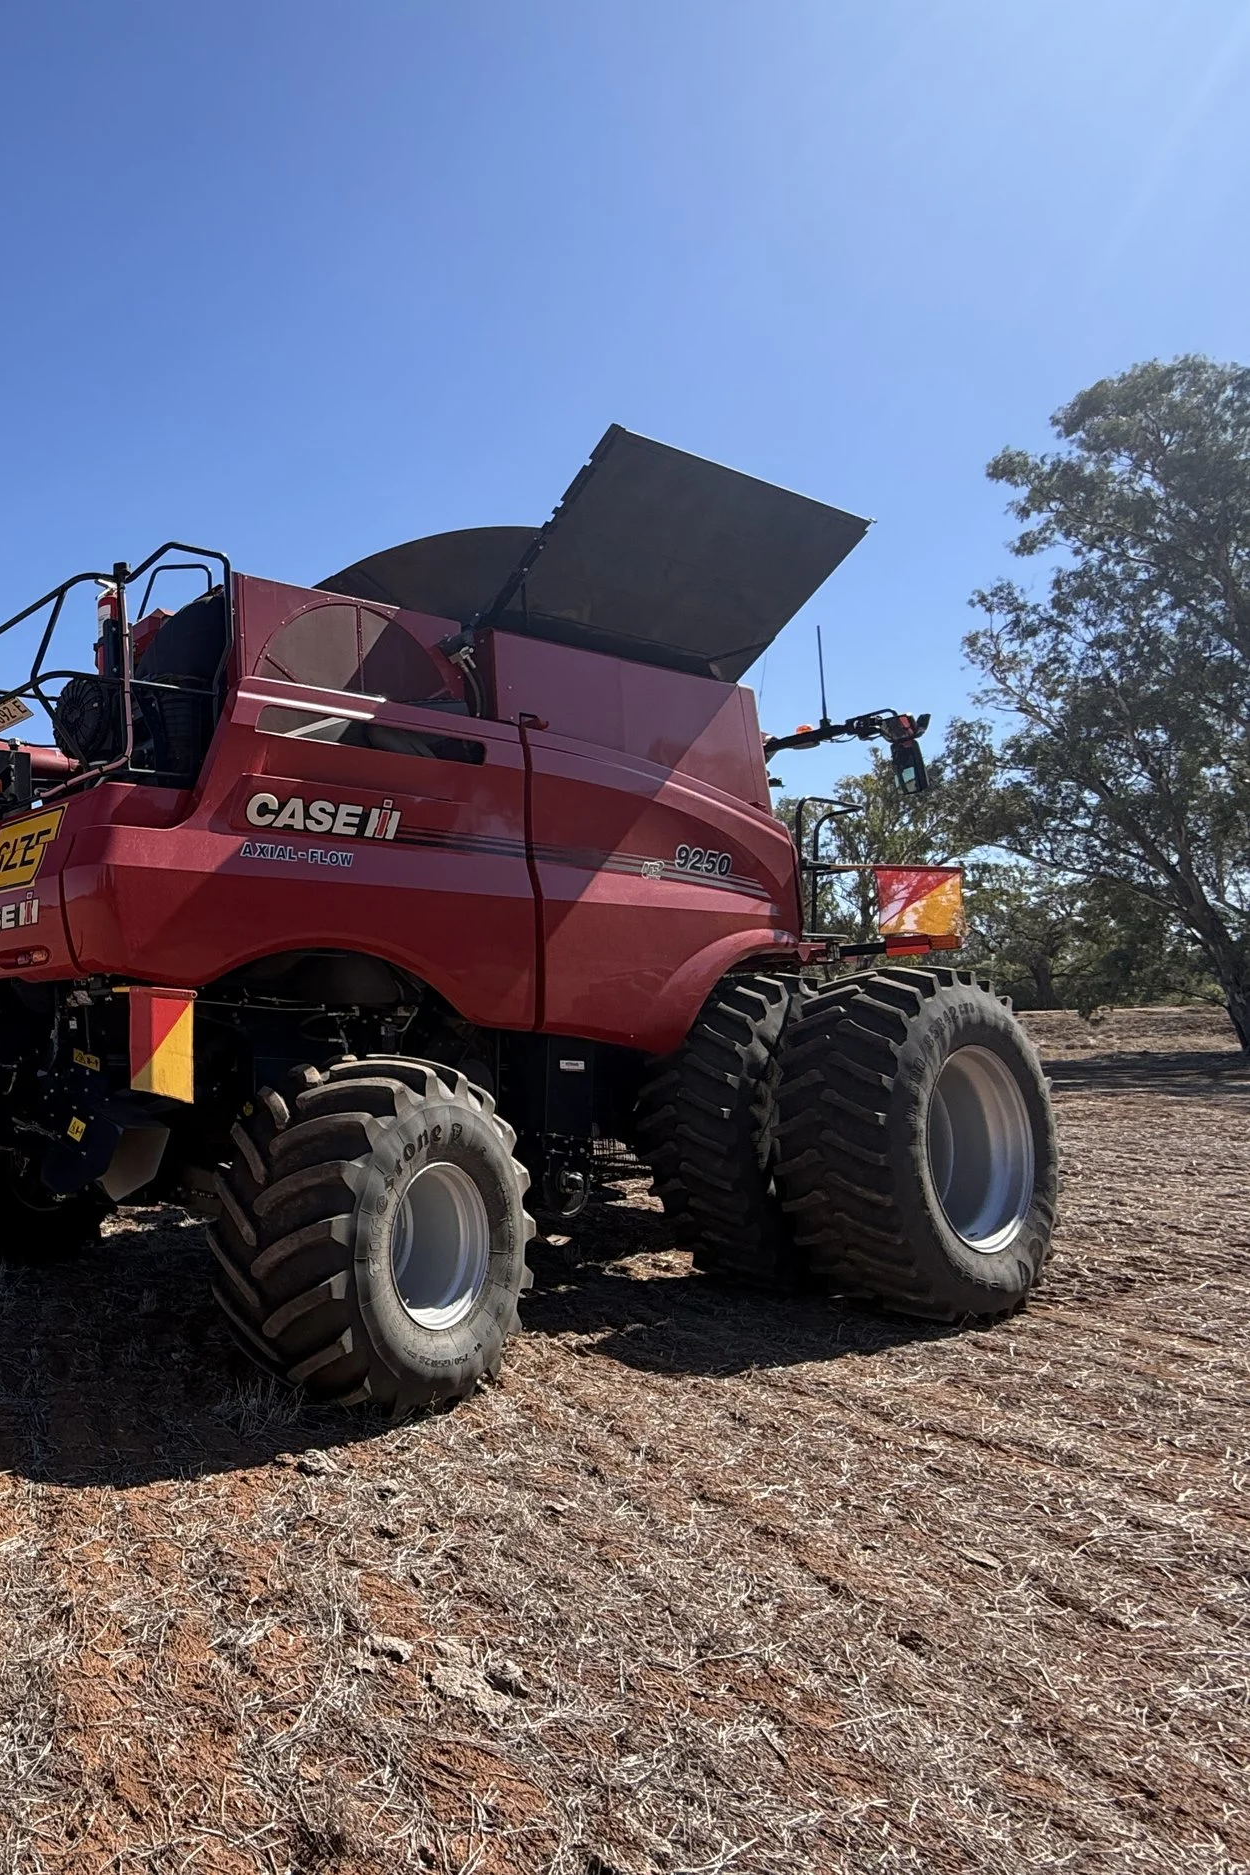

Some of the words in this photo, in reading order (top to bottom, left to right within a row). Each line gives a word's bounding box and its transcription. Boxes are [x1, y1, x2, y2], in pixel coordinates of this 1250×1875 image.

[246, 793, 363, 836] CASE
[240, 842, 354, 867] AXIAL-FLOW
[675, 844, 732, 877] 9250
[367, 1123, 442, 1278] Firestone
